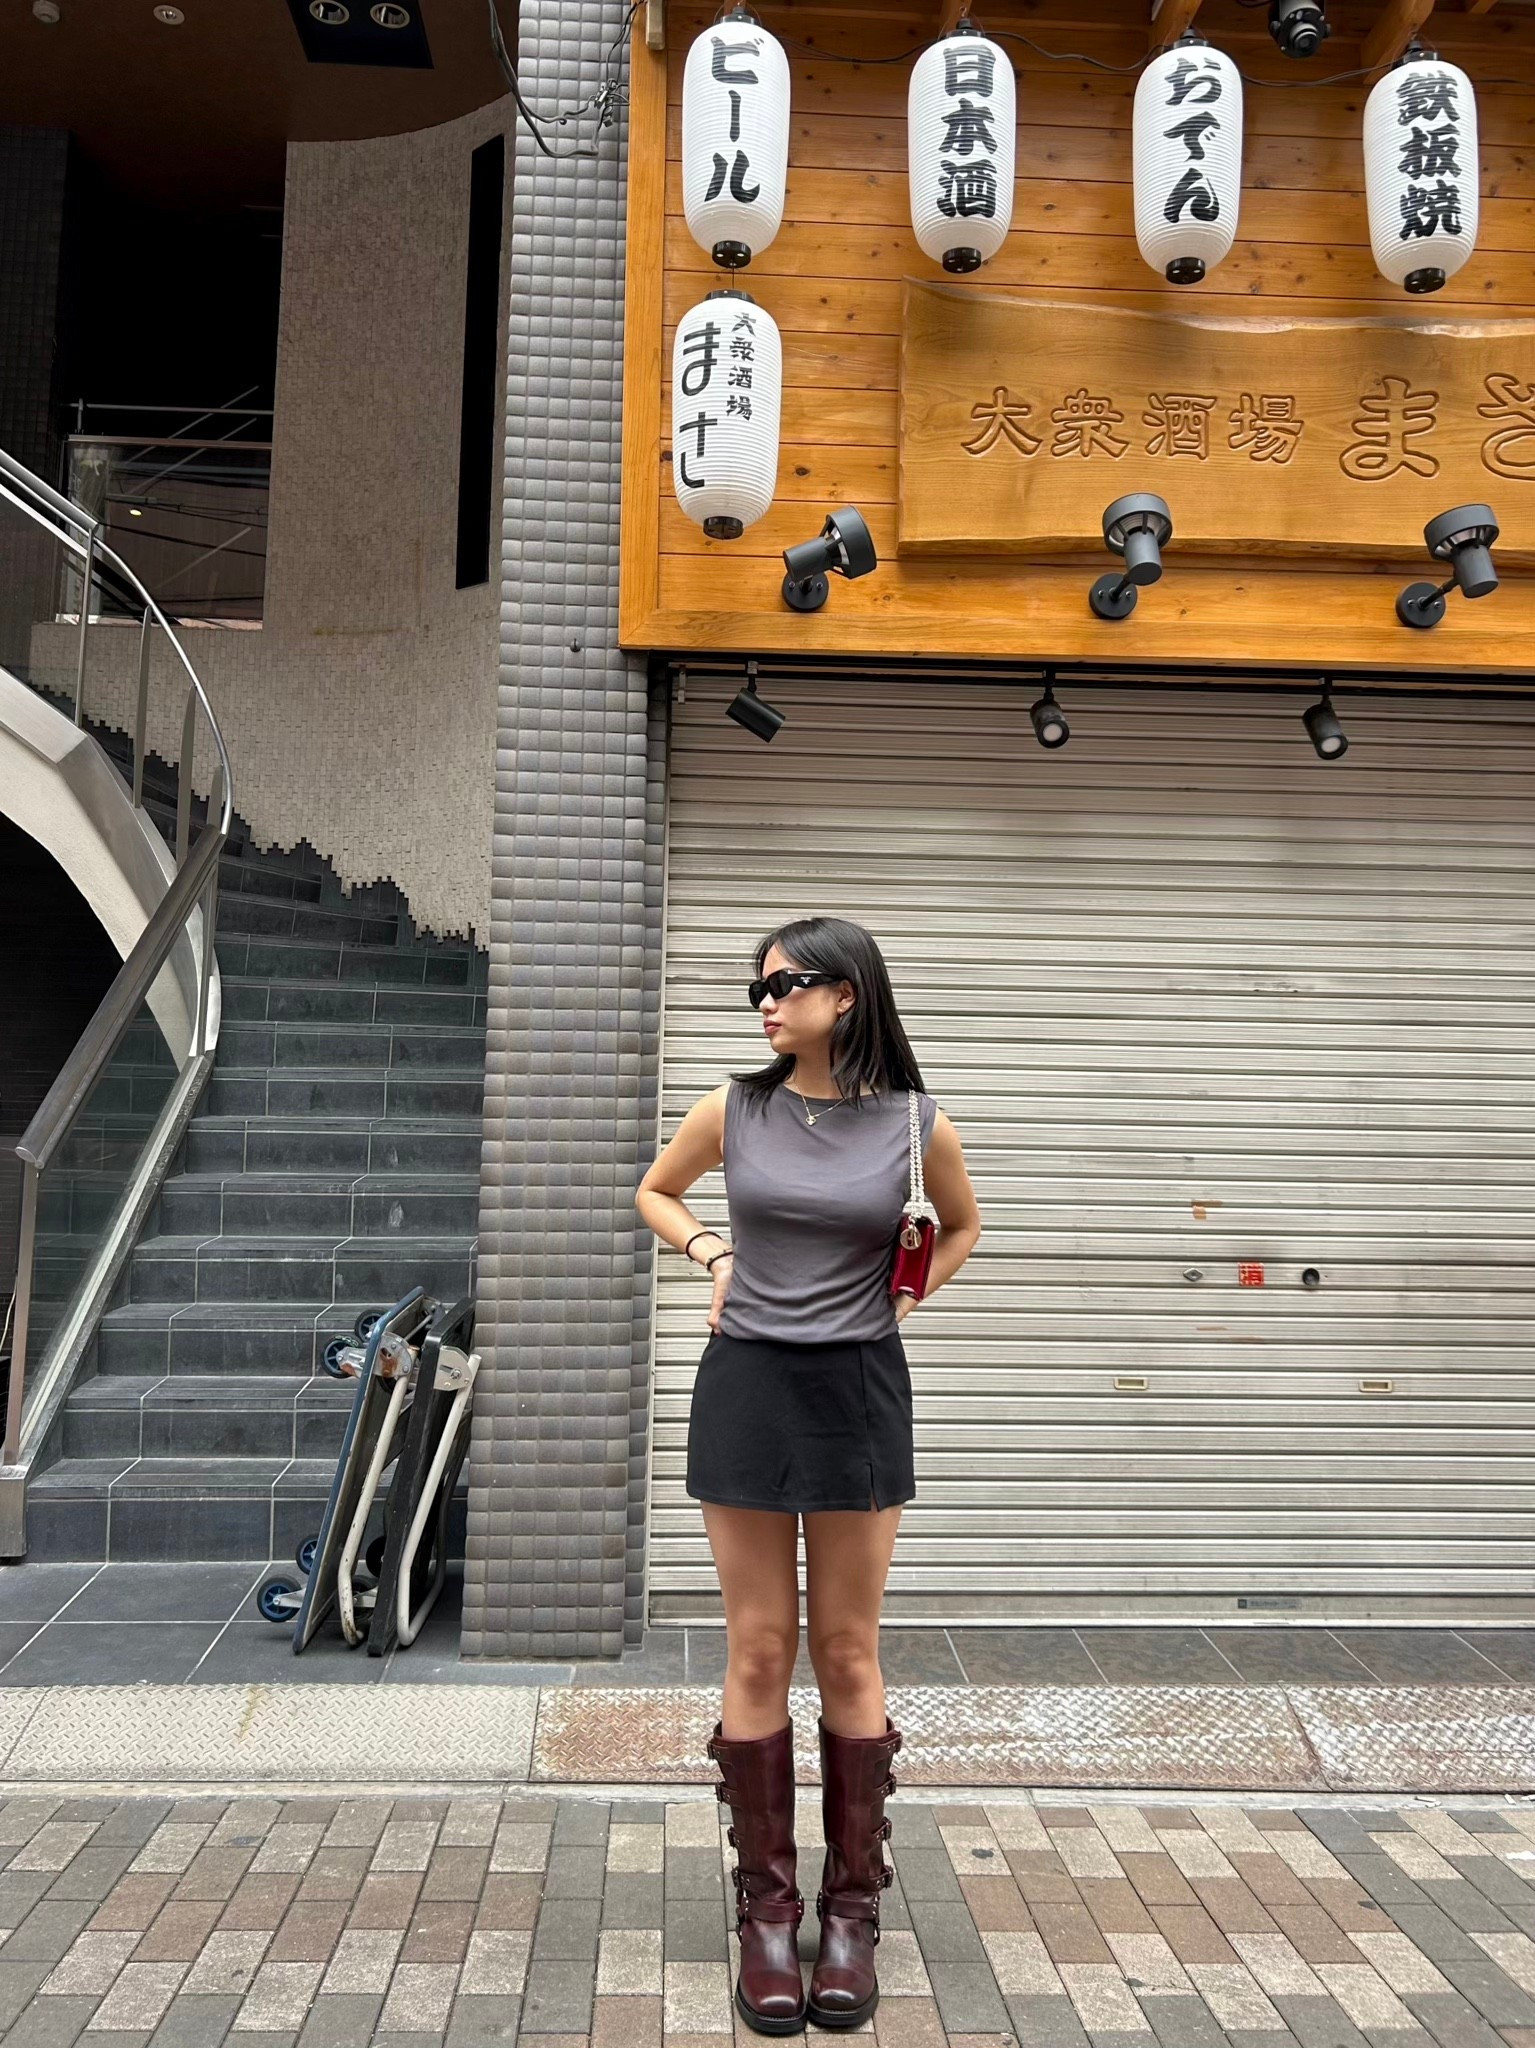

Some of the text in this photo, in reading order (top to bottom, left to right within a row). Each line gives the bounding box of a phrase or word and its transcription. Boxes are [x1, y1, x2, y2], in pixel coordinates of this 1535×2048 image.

[704, 36, 765, 204] ビール
[937, 45, 999, 219] 日本酒
[1162, 57, 1223, 224] おでん
[726, 312, 757, 421] 大衆酒場
[960, 386, 1304, 465] 大衆酒場
